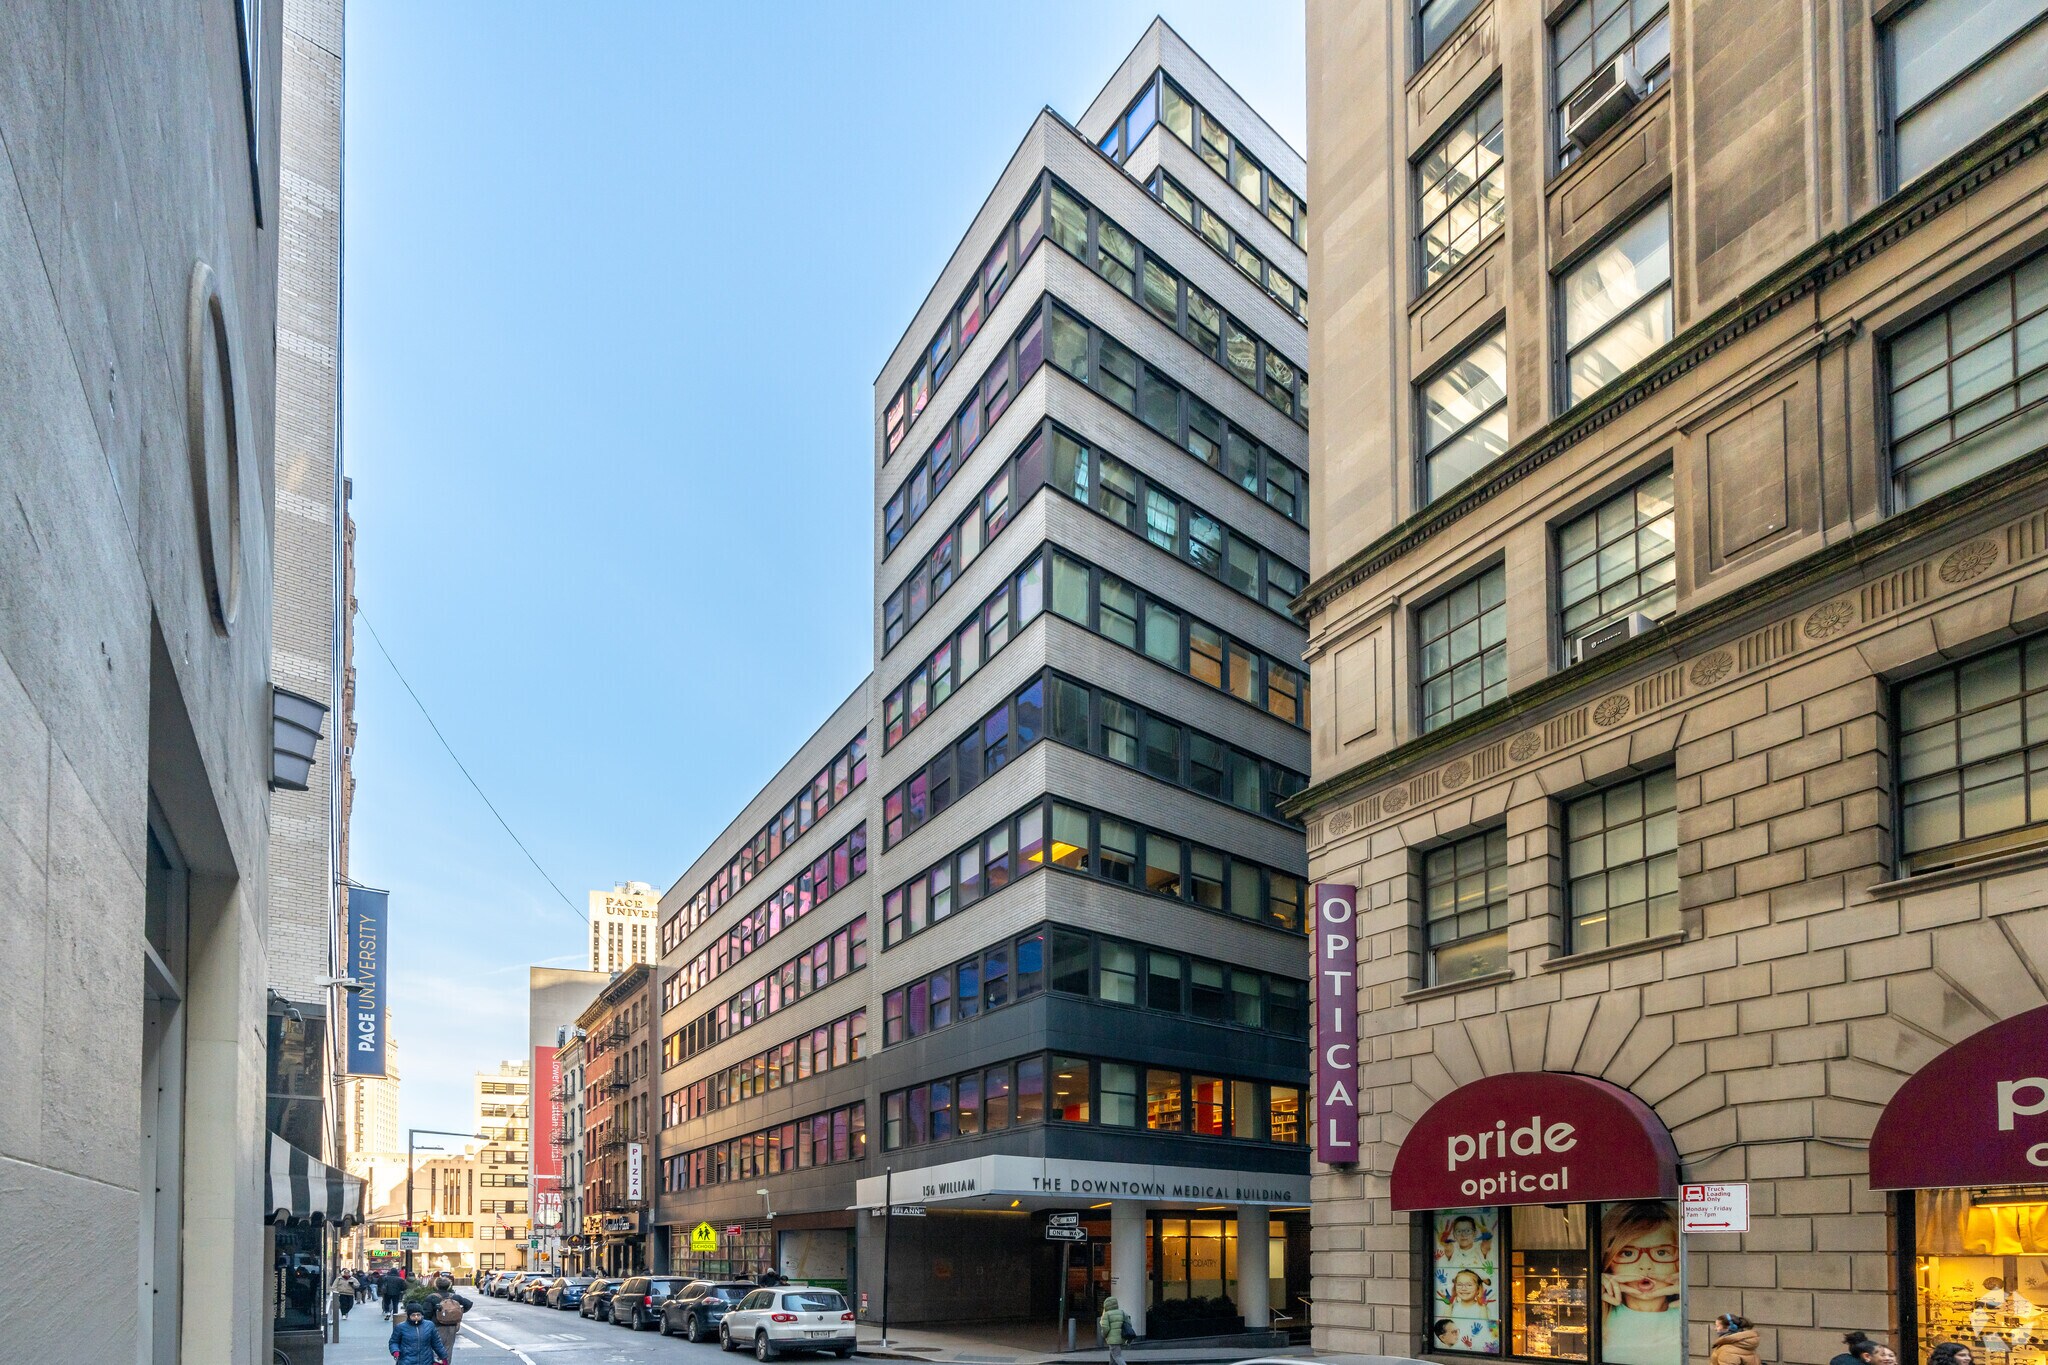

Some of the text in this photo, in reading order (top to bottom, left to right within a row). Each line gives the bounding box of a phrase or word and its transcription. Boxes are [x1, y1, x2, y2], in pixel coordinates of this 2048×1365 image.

[606, 898, 643, 908] PACE
[358, 914, 377, 1051] PACE UNIVERSITY
[1323, 897, 1353, 1147] OPTICAL
[552, 1061, 561, 1083] Lower
[1448, 1116, 1578, 1171] pride
[631, 1148, 639, 1196] PIZZA
[922, 1179, 976, 1196] 156 WILLIAM
[1033, 1177, 1292, 1200] THE DOWNTOWN MEDICAL BUILDING
[1461, 1166, 1568, 1199] optical
